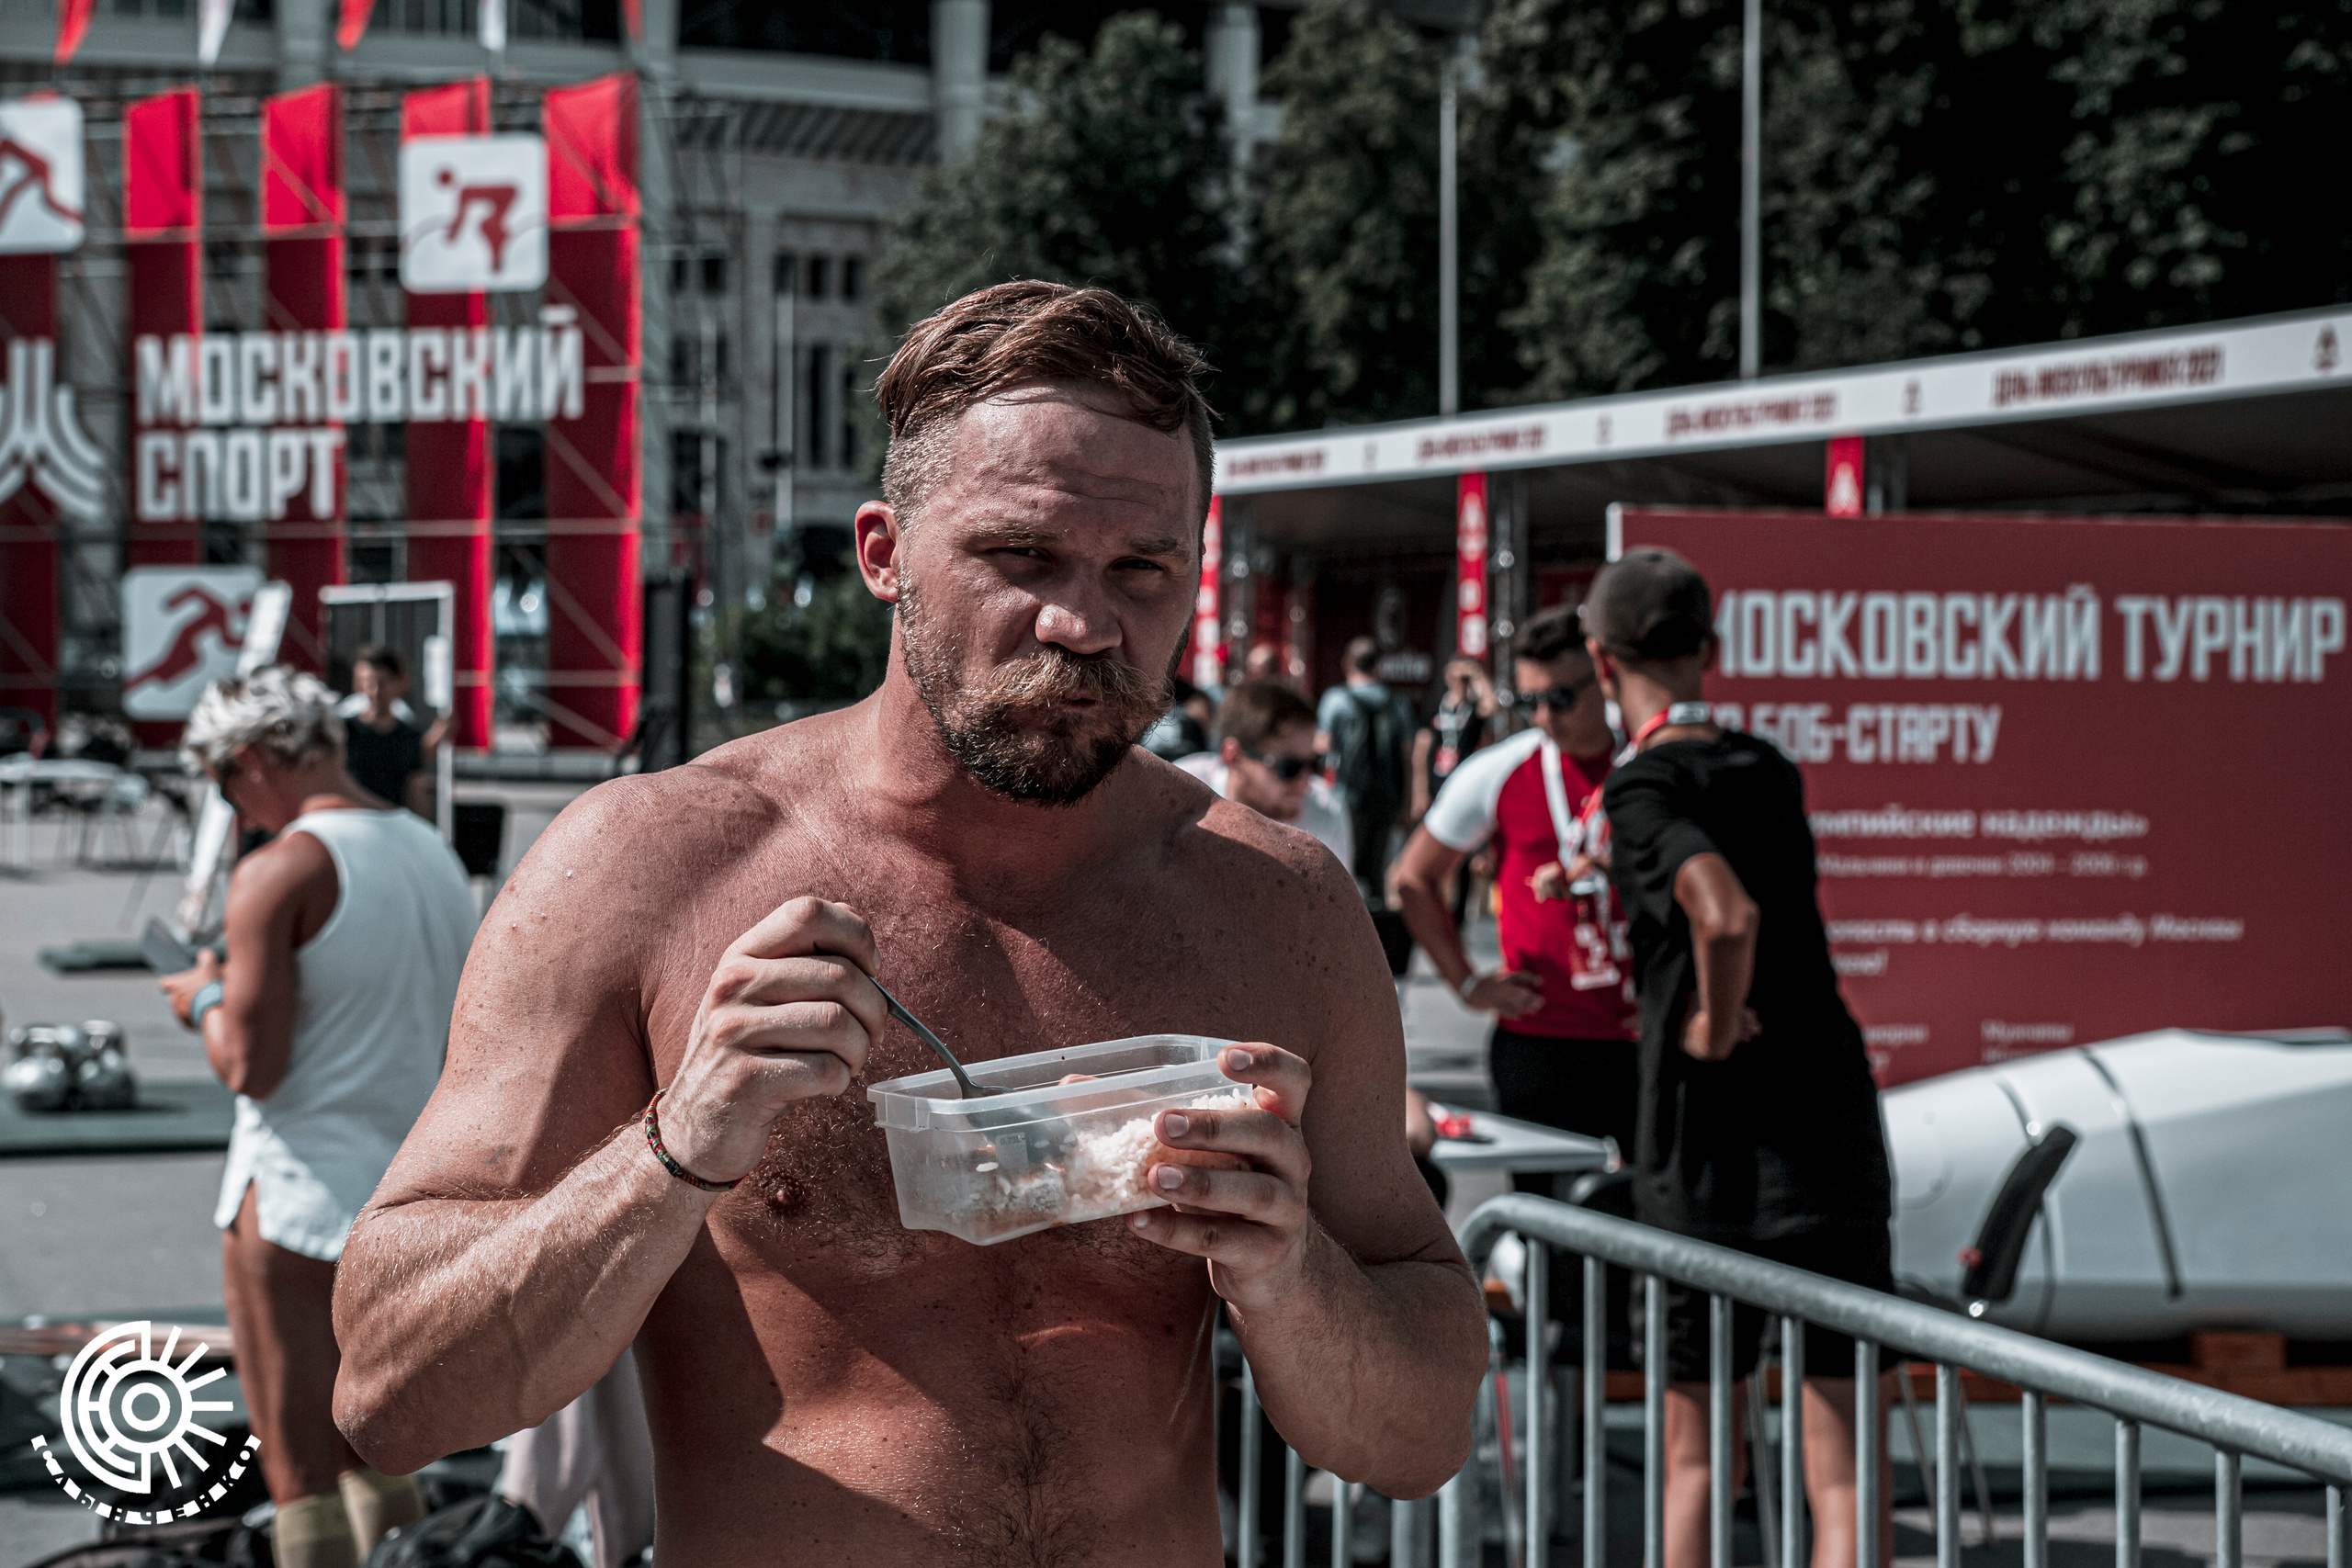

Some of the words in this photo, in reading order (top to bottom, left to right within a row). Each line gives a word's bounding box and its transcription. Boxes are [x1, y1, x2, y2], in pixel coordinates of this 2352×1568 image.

[134, 303, 584, 426] МОСКОВСКИЙ
[136, 426, 345, 521] СПОРТ
[2115, 594, 2346, 683] ТУРНИР
